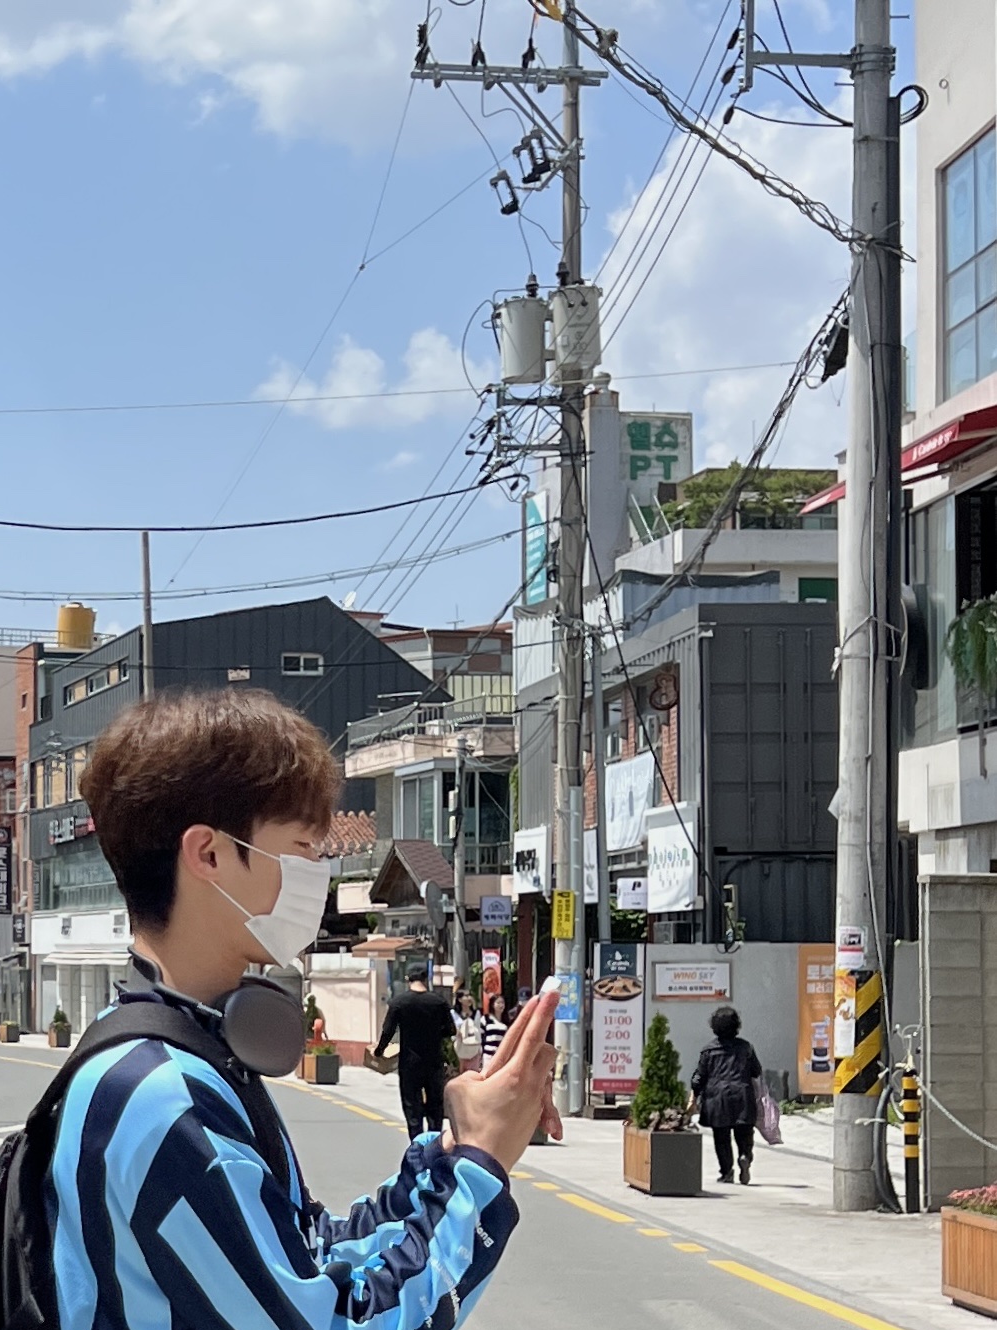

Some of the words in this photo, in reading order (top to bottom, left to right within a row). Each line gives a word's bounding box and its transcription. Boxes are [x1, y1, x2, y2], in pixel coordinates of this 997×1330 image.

[627, 421, 679, 451] 헬스
[629, 455, 678, 481] PT
[673, 971, 697, 980] WING
[698, 971, 715, 980] SKY
[603, 1015, 632, 1025] 11:00
[605, 1030, 630, 1040] 2:00
[602, 1052, 632, 1064] 20%
